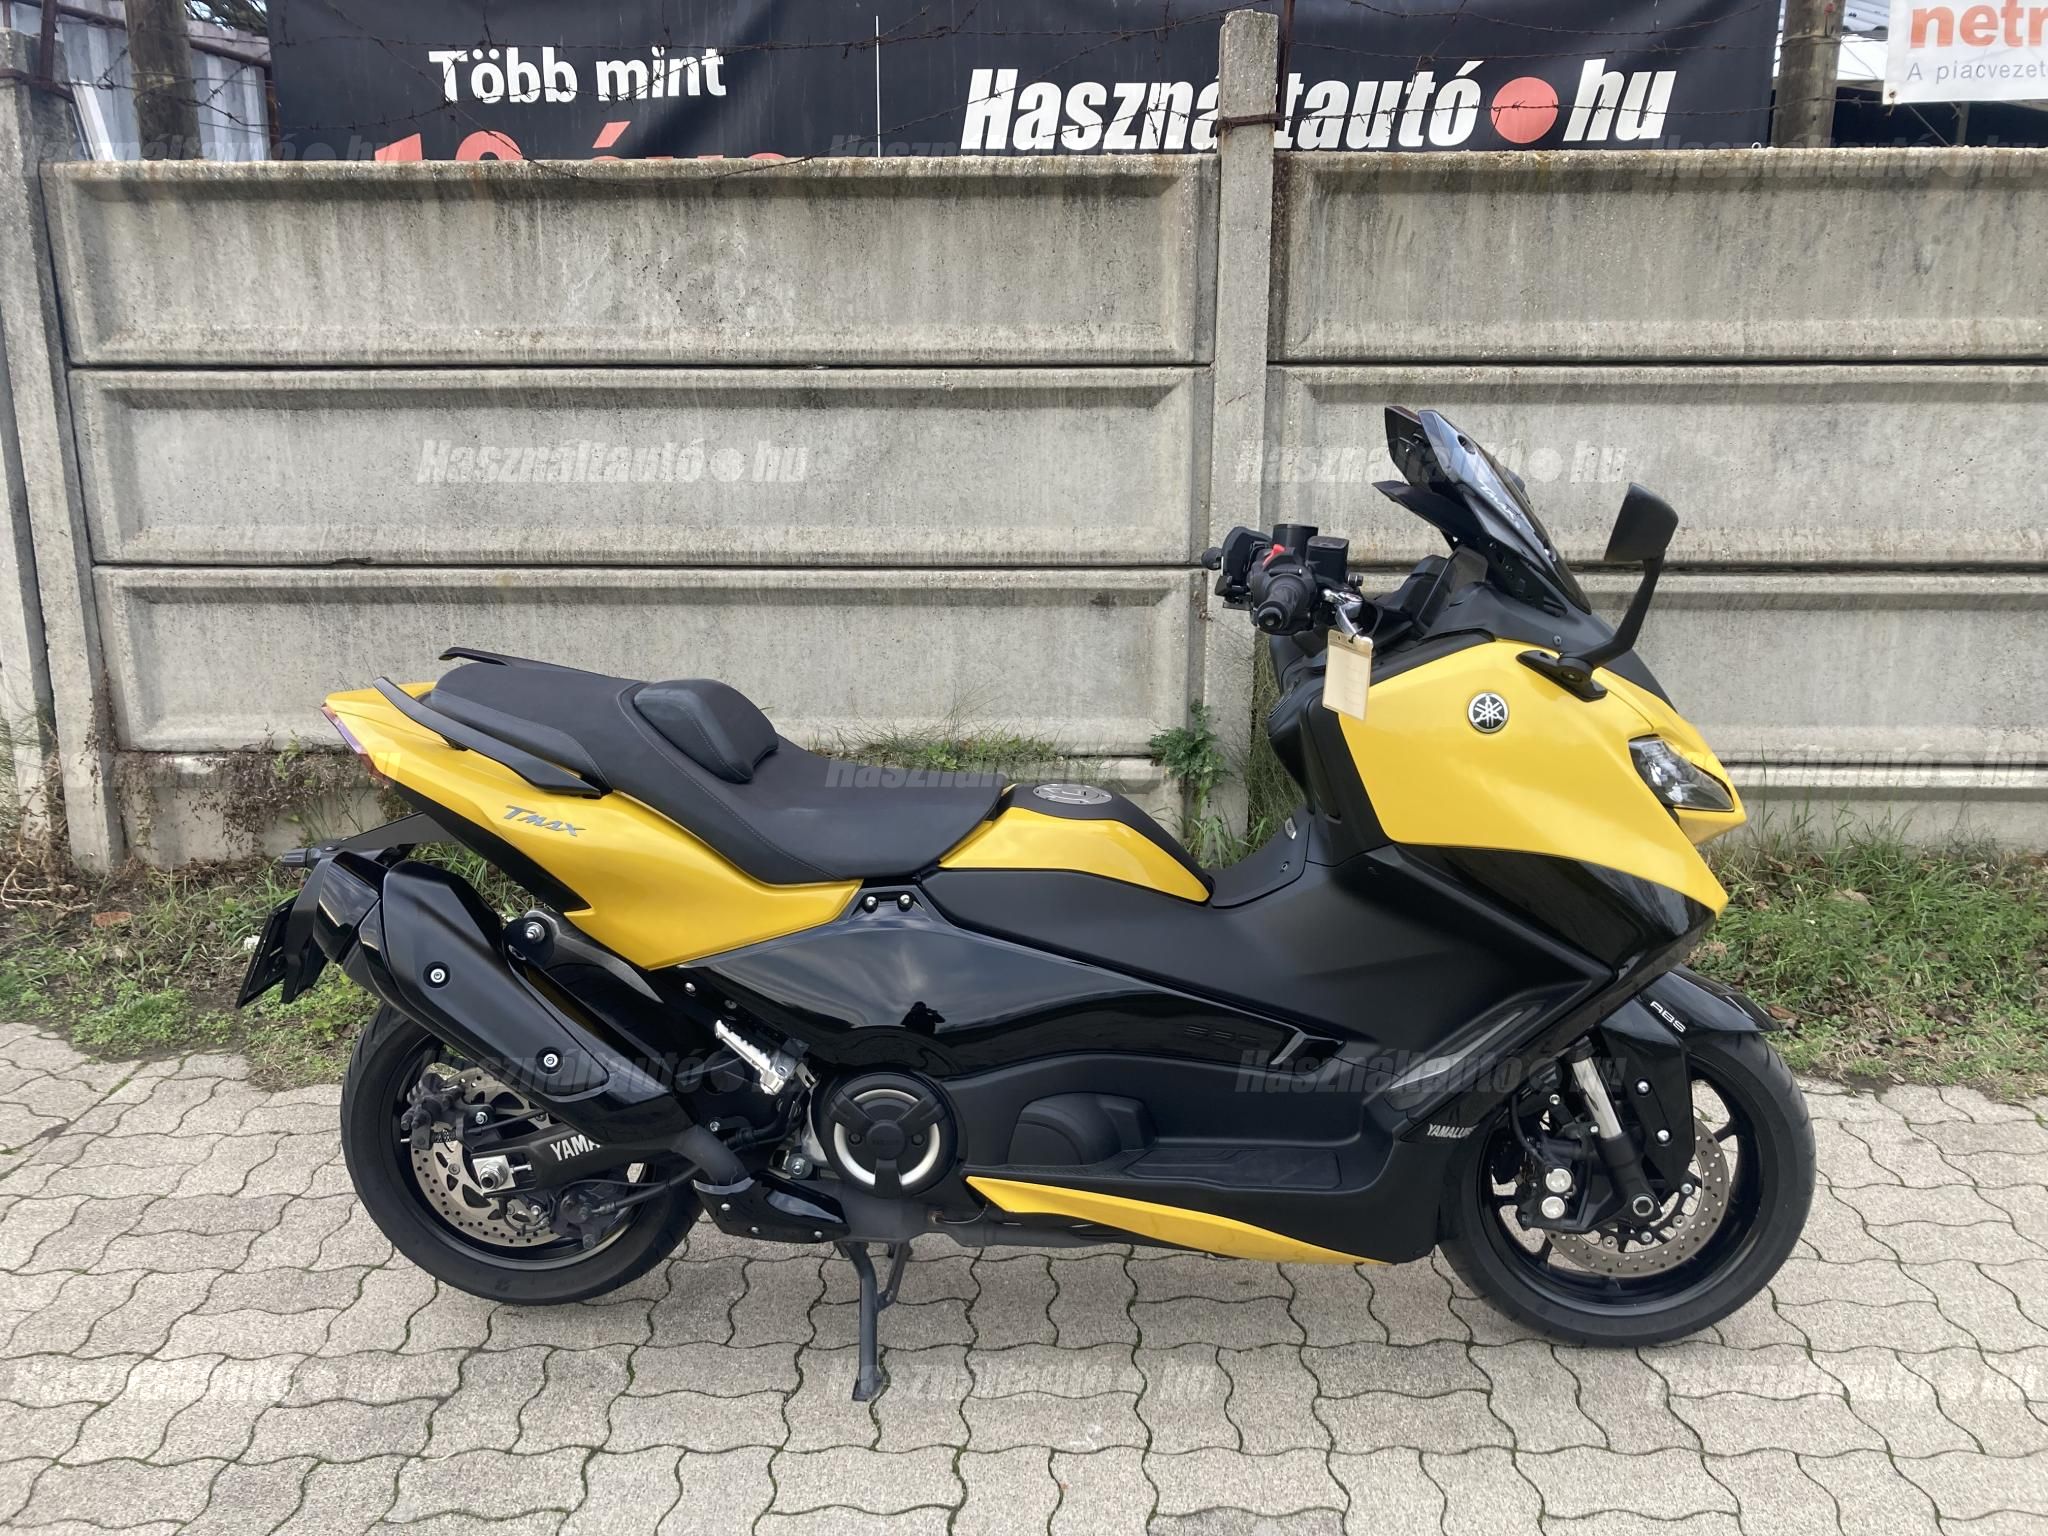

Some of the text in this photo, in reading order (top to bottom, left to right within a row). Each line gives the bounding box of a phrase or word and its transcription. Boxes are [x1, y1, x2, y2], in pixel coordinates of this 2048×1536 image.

[428, 46, 727, 103] Több mint
[1907, 60, 2047, 84] A piacvezet
[1649, 1000, 1687, 1033] ABS
